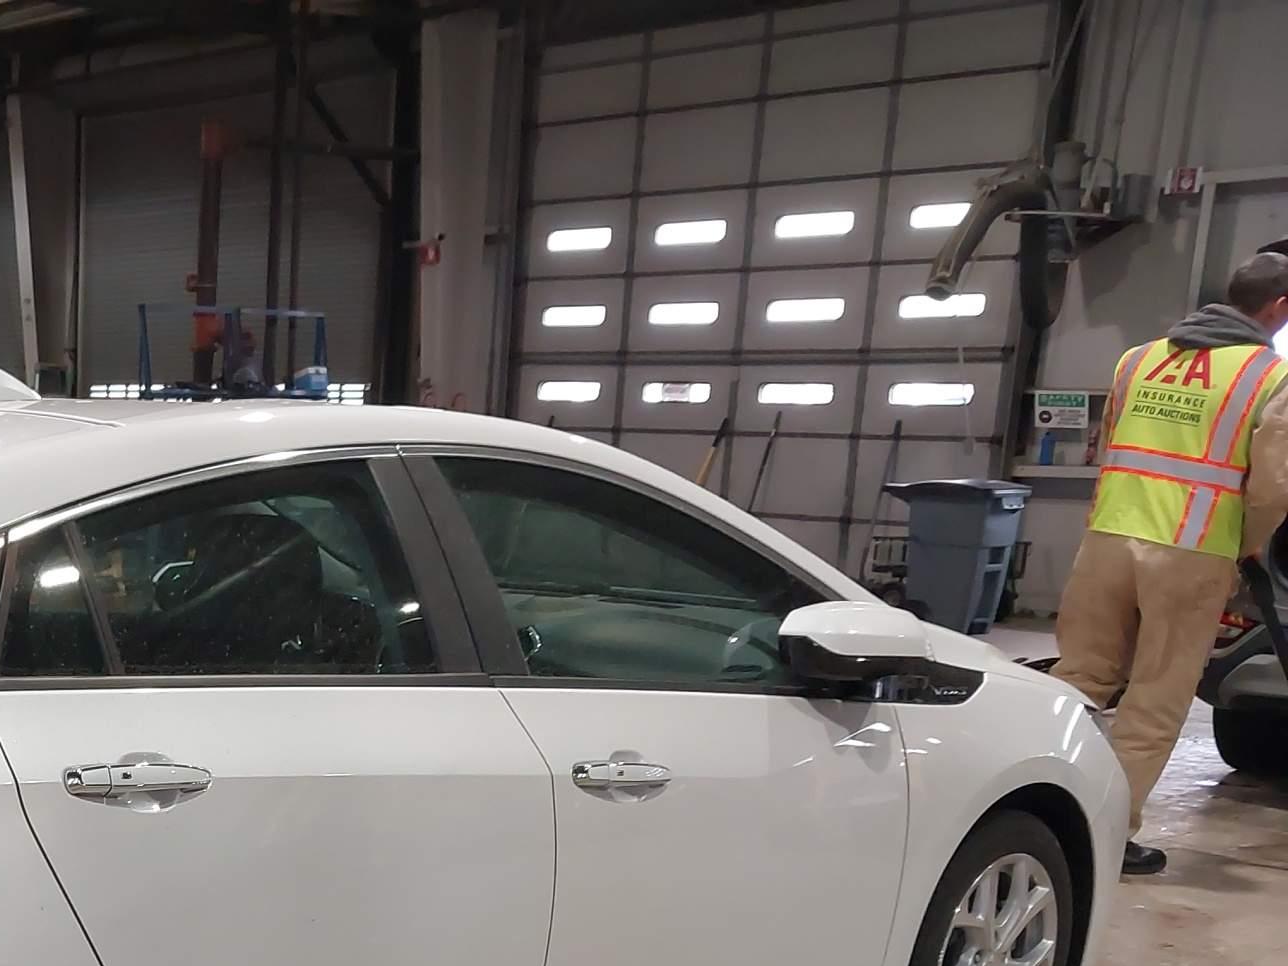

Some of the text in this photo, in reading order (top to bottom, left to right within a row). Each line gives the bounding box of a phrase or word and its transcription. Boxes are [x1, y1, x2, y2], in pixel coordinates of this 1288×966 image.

[1136, 389, 1206, 409] INSURANCE
[1132, 404, 1201, 424] AUTO AUCTIONS
